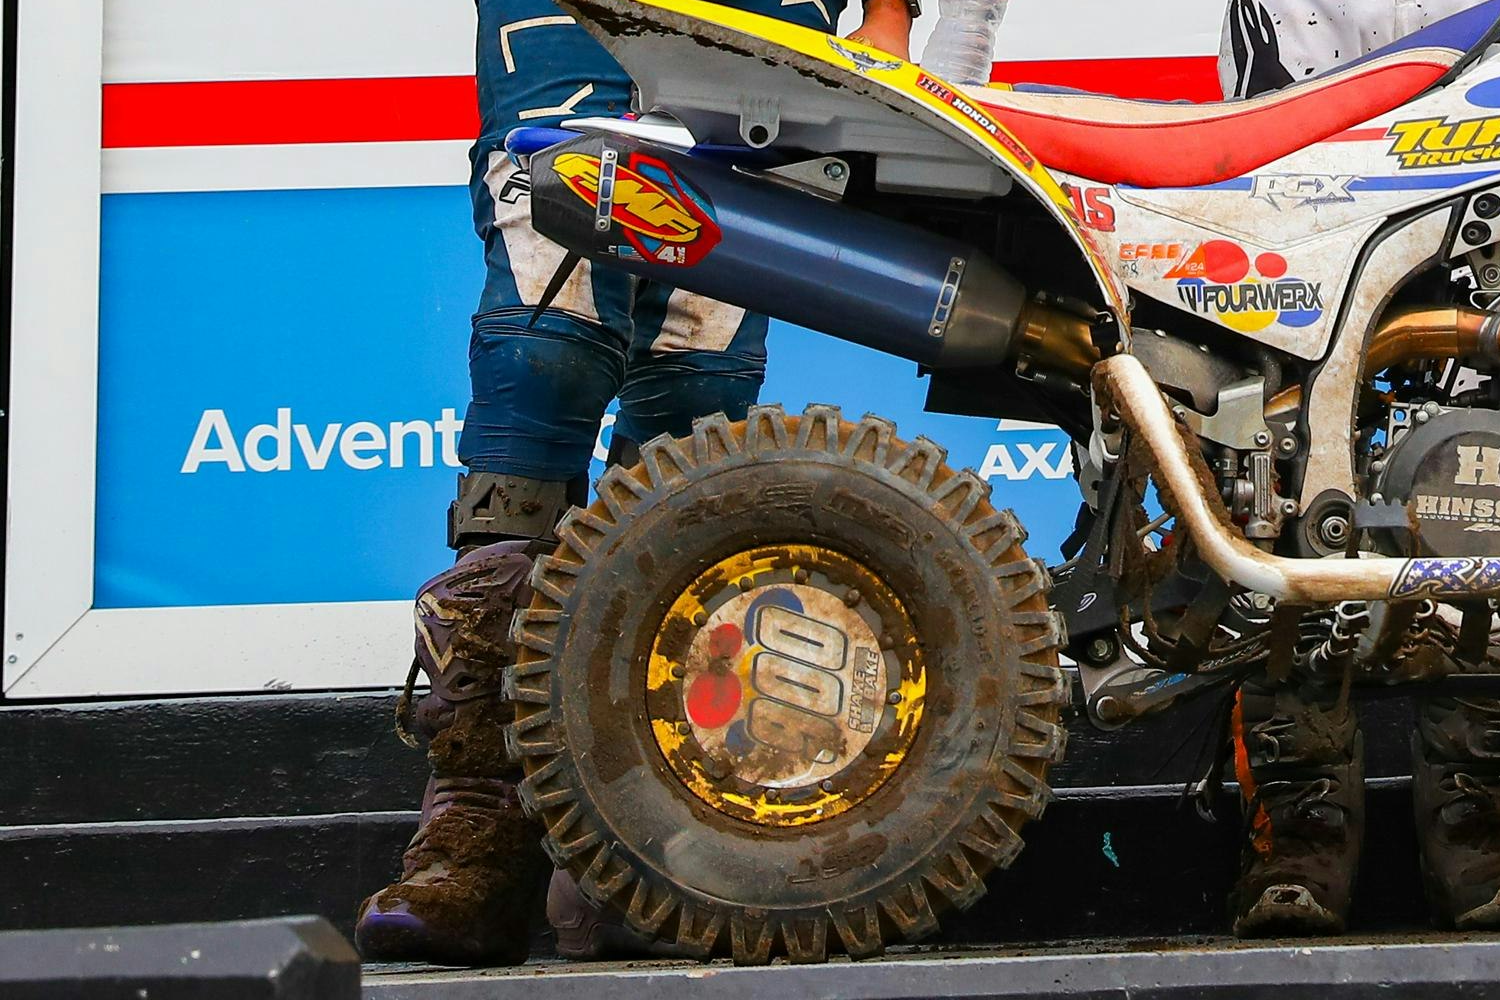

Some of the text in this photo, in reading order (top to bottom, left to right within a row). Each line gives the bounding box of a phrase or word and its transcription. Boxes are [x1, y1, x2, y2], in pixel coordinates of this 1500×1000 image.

[952, 98, 997, 134] HONDA
[1203, 283, 1323, 313] FOURWERX
[862, 647, 880, 699] BAKE
[847, 669, 866, 731] SHAKE
